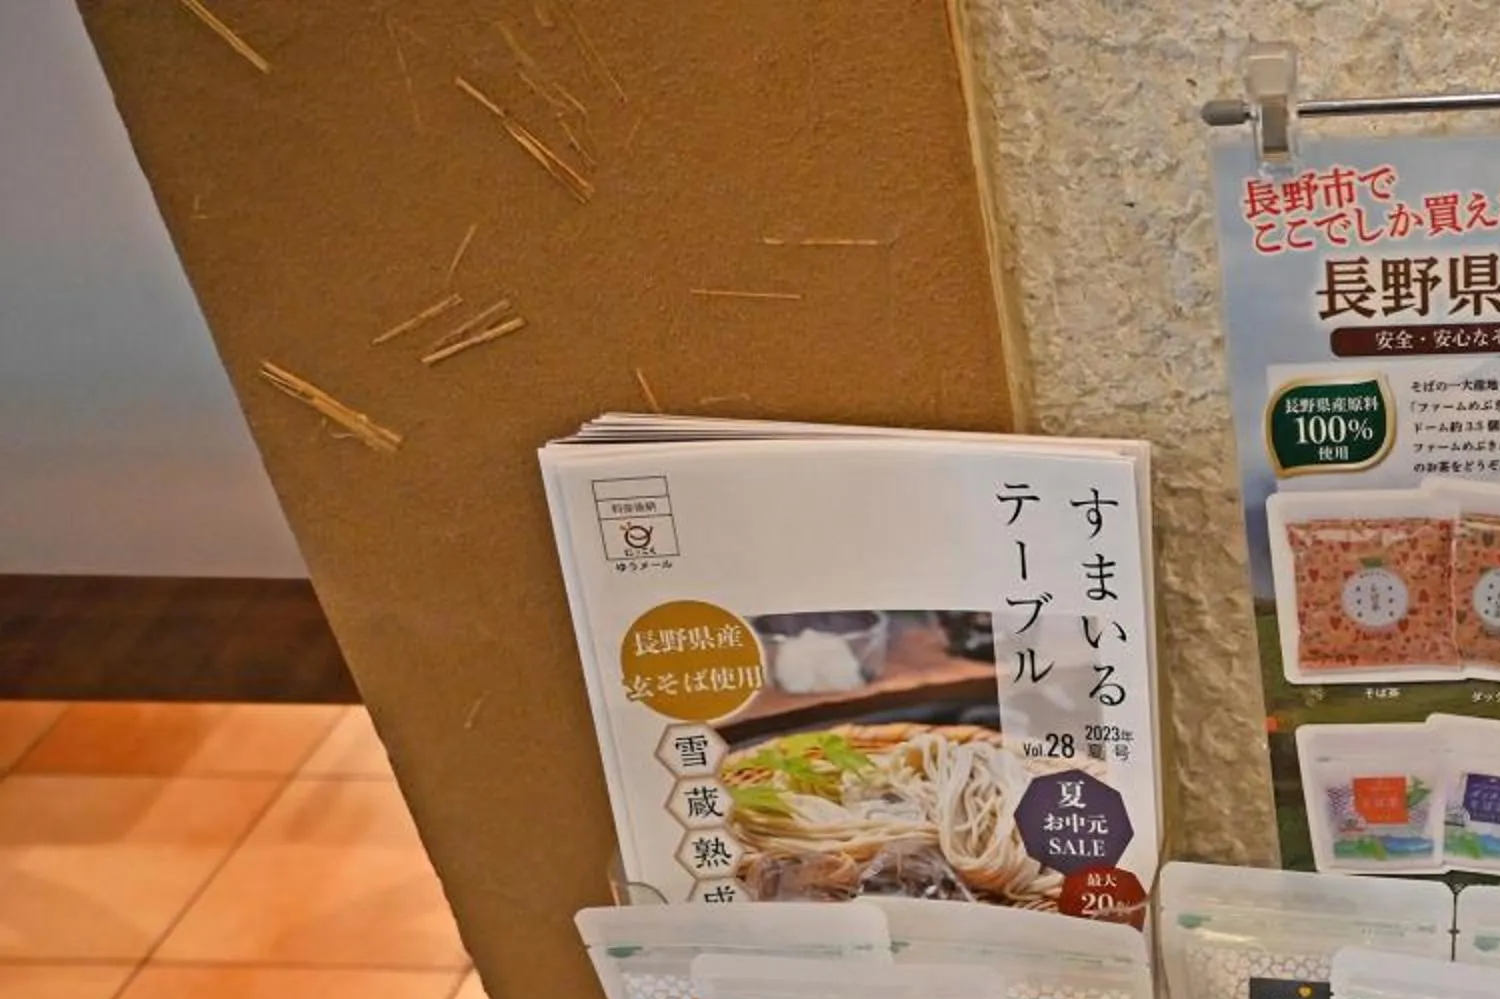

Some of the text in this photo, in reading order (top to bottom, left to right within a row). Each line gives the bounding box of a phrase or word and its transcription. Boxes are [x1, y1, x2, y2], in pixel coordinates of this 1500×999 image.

[1246, 167, 1395, 219] 長野市で
[1285, 396, 1379, 414] 長野県産原料
[1295, 415, 1374, 445] 100%
[1319, 445, 1350, 461] 使用
[996, 482, 1055, 684] テーブル
[1069, 487, 1128, 707] すまいる
[633, 624, 744, 656] 長野県産
[626, 664, 764, 701] 玄そば使用
[1056, 779, 1087, 810] 夏
[1042, 812, 1110, 835] お中元
[1048, 837, 1106, 858] SALE
[1086, 872, 1117, 889] 最大
